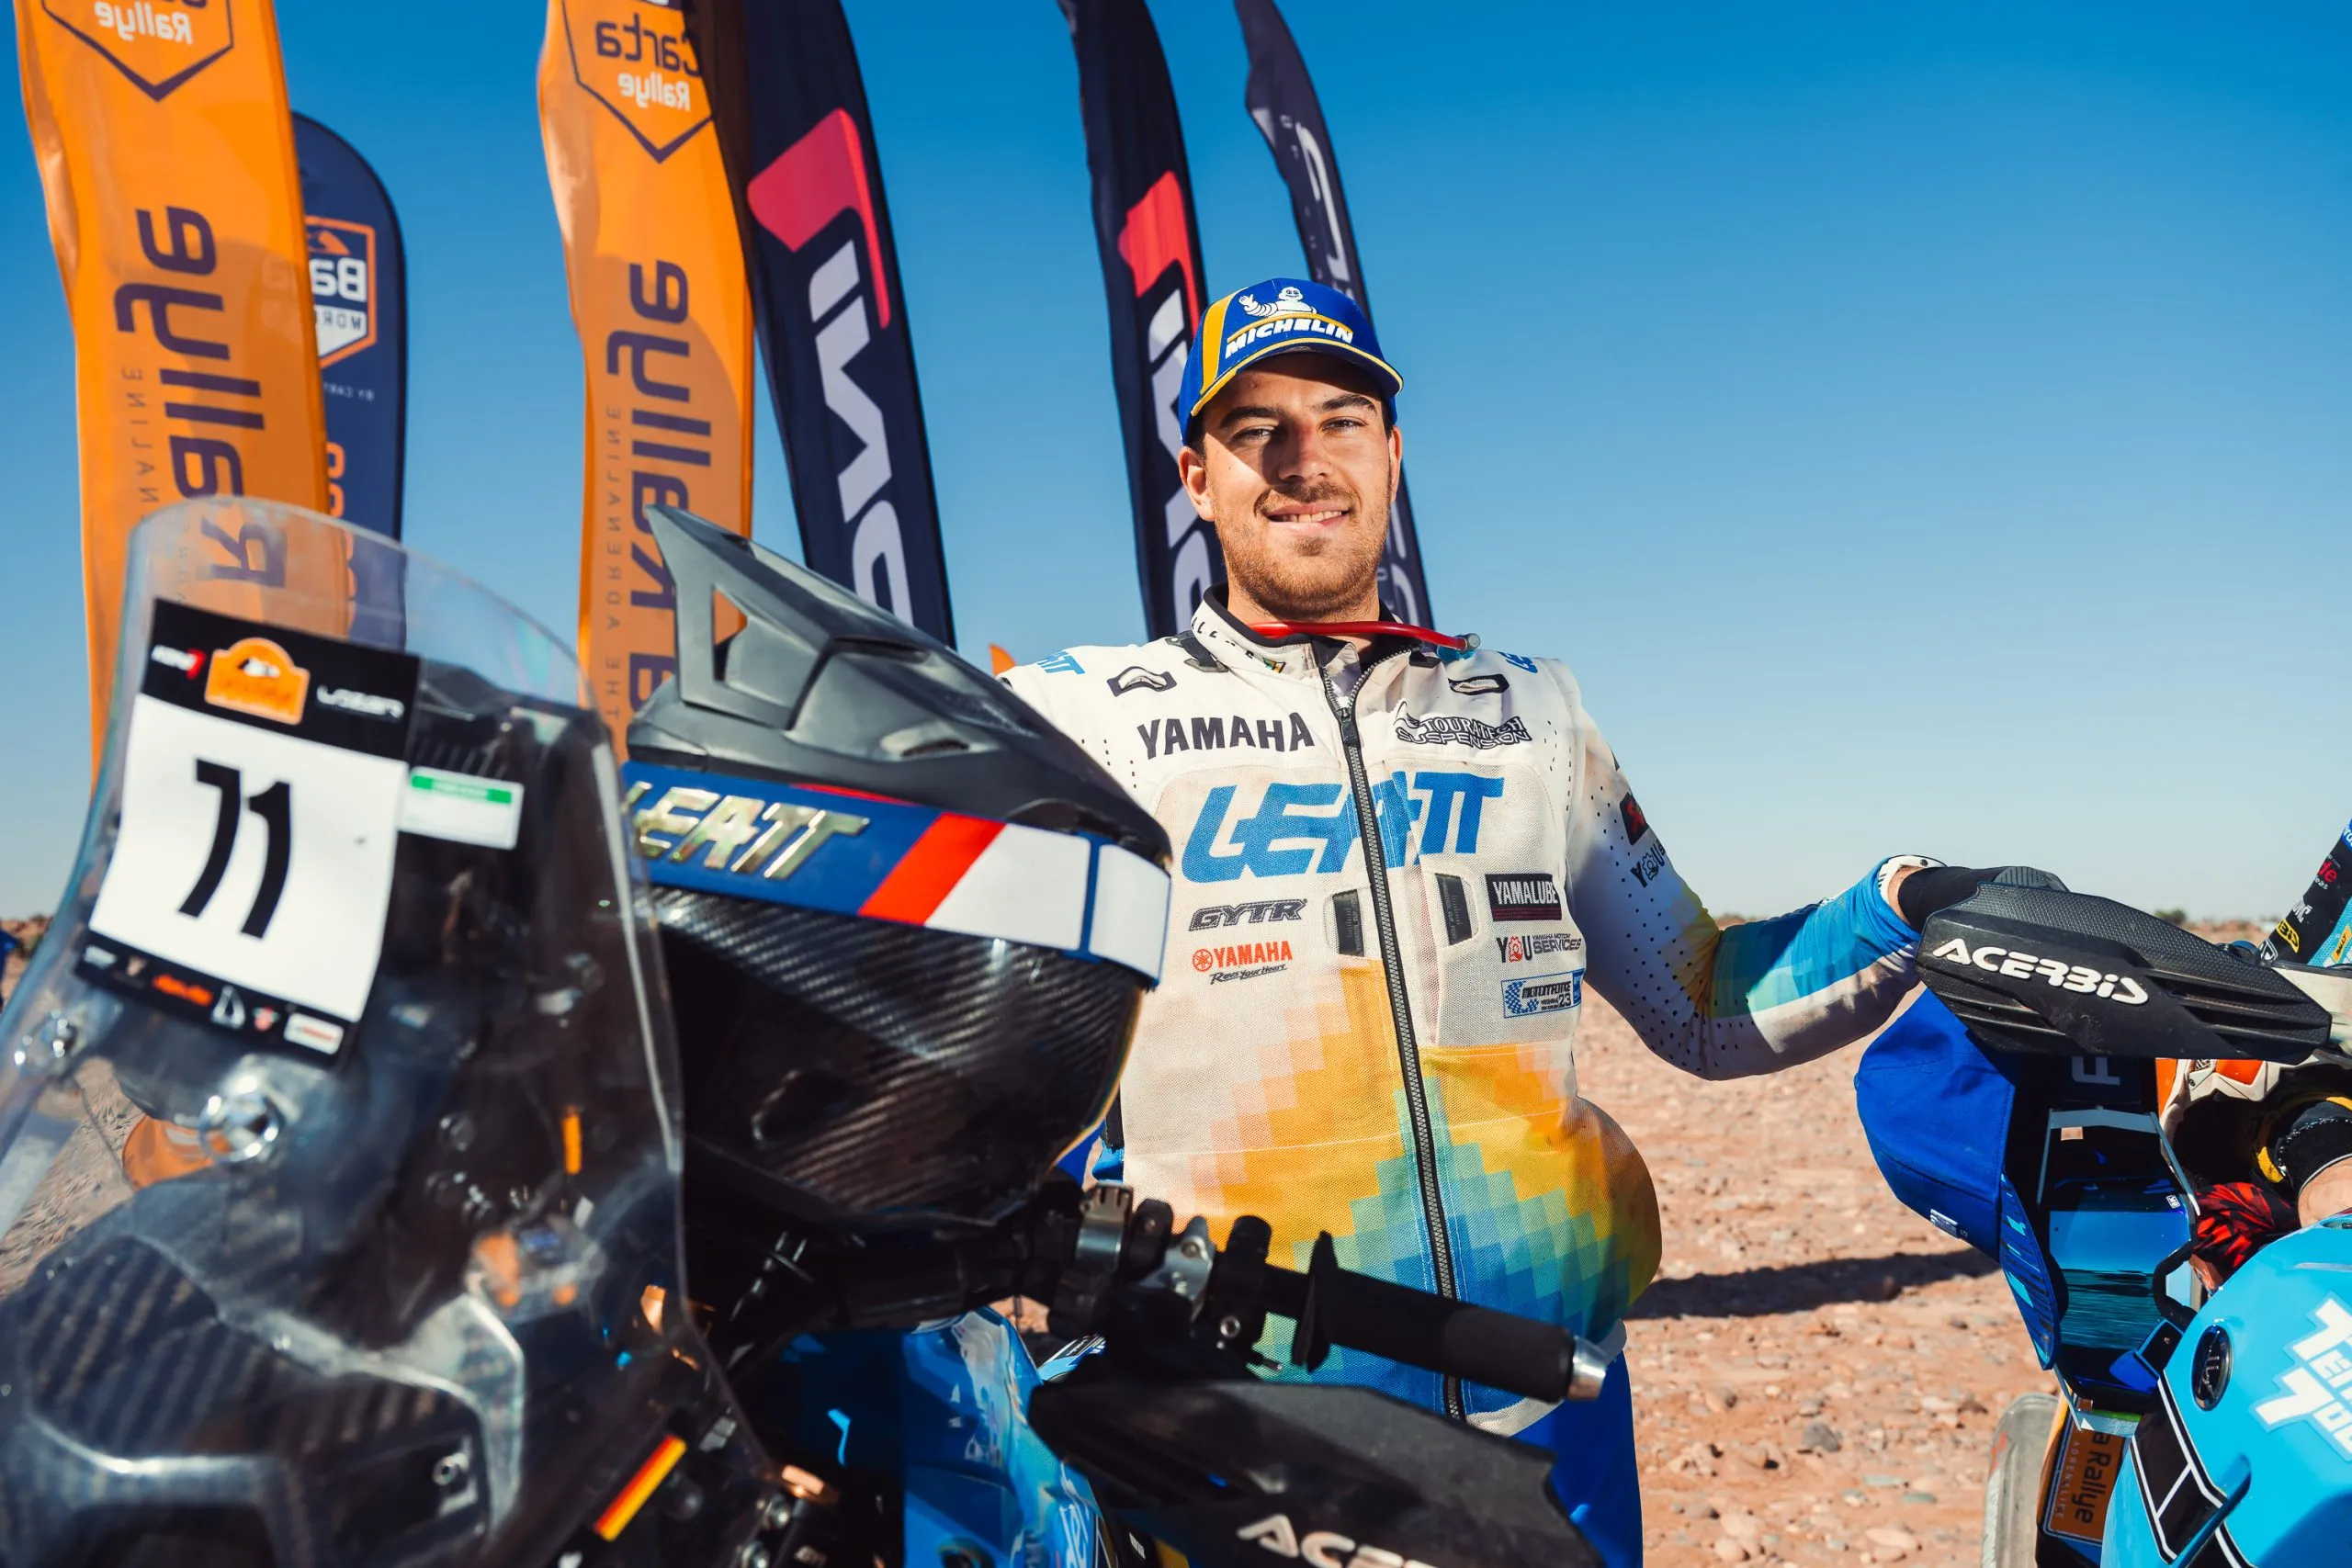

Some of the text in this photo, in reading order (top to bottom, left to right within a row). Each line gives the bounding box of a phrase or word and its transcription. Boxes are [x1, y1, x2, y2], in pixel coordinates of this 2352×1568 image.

[1225, 319, 1354, 359] MICHELIN
[1136, 712, 1315, 760] YAMAHA
[1396, 727, 1532, 750] SUSPENSION
[1424, 716, 1527, 739] TOURATECH
[1182, 770, 1505, 884] LEATT
[176, 758, 291, 940] 71
[1493, 882, 1559, 905] YAMALUBE
[1189, 899, 1306, 931] GYTR
[1214, 941, 1293, 968] YAMAHA
[1533, 938, 1581, 954] SERVICES
[1932, 938, 2149, 1005] ACERBIS
[1558, 992, 1572, 1008] 23
[2072, 1450, 2111, 1524] Rallye
